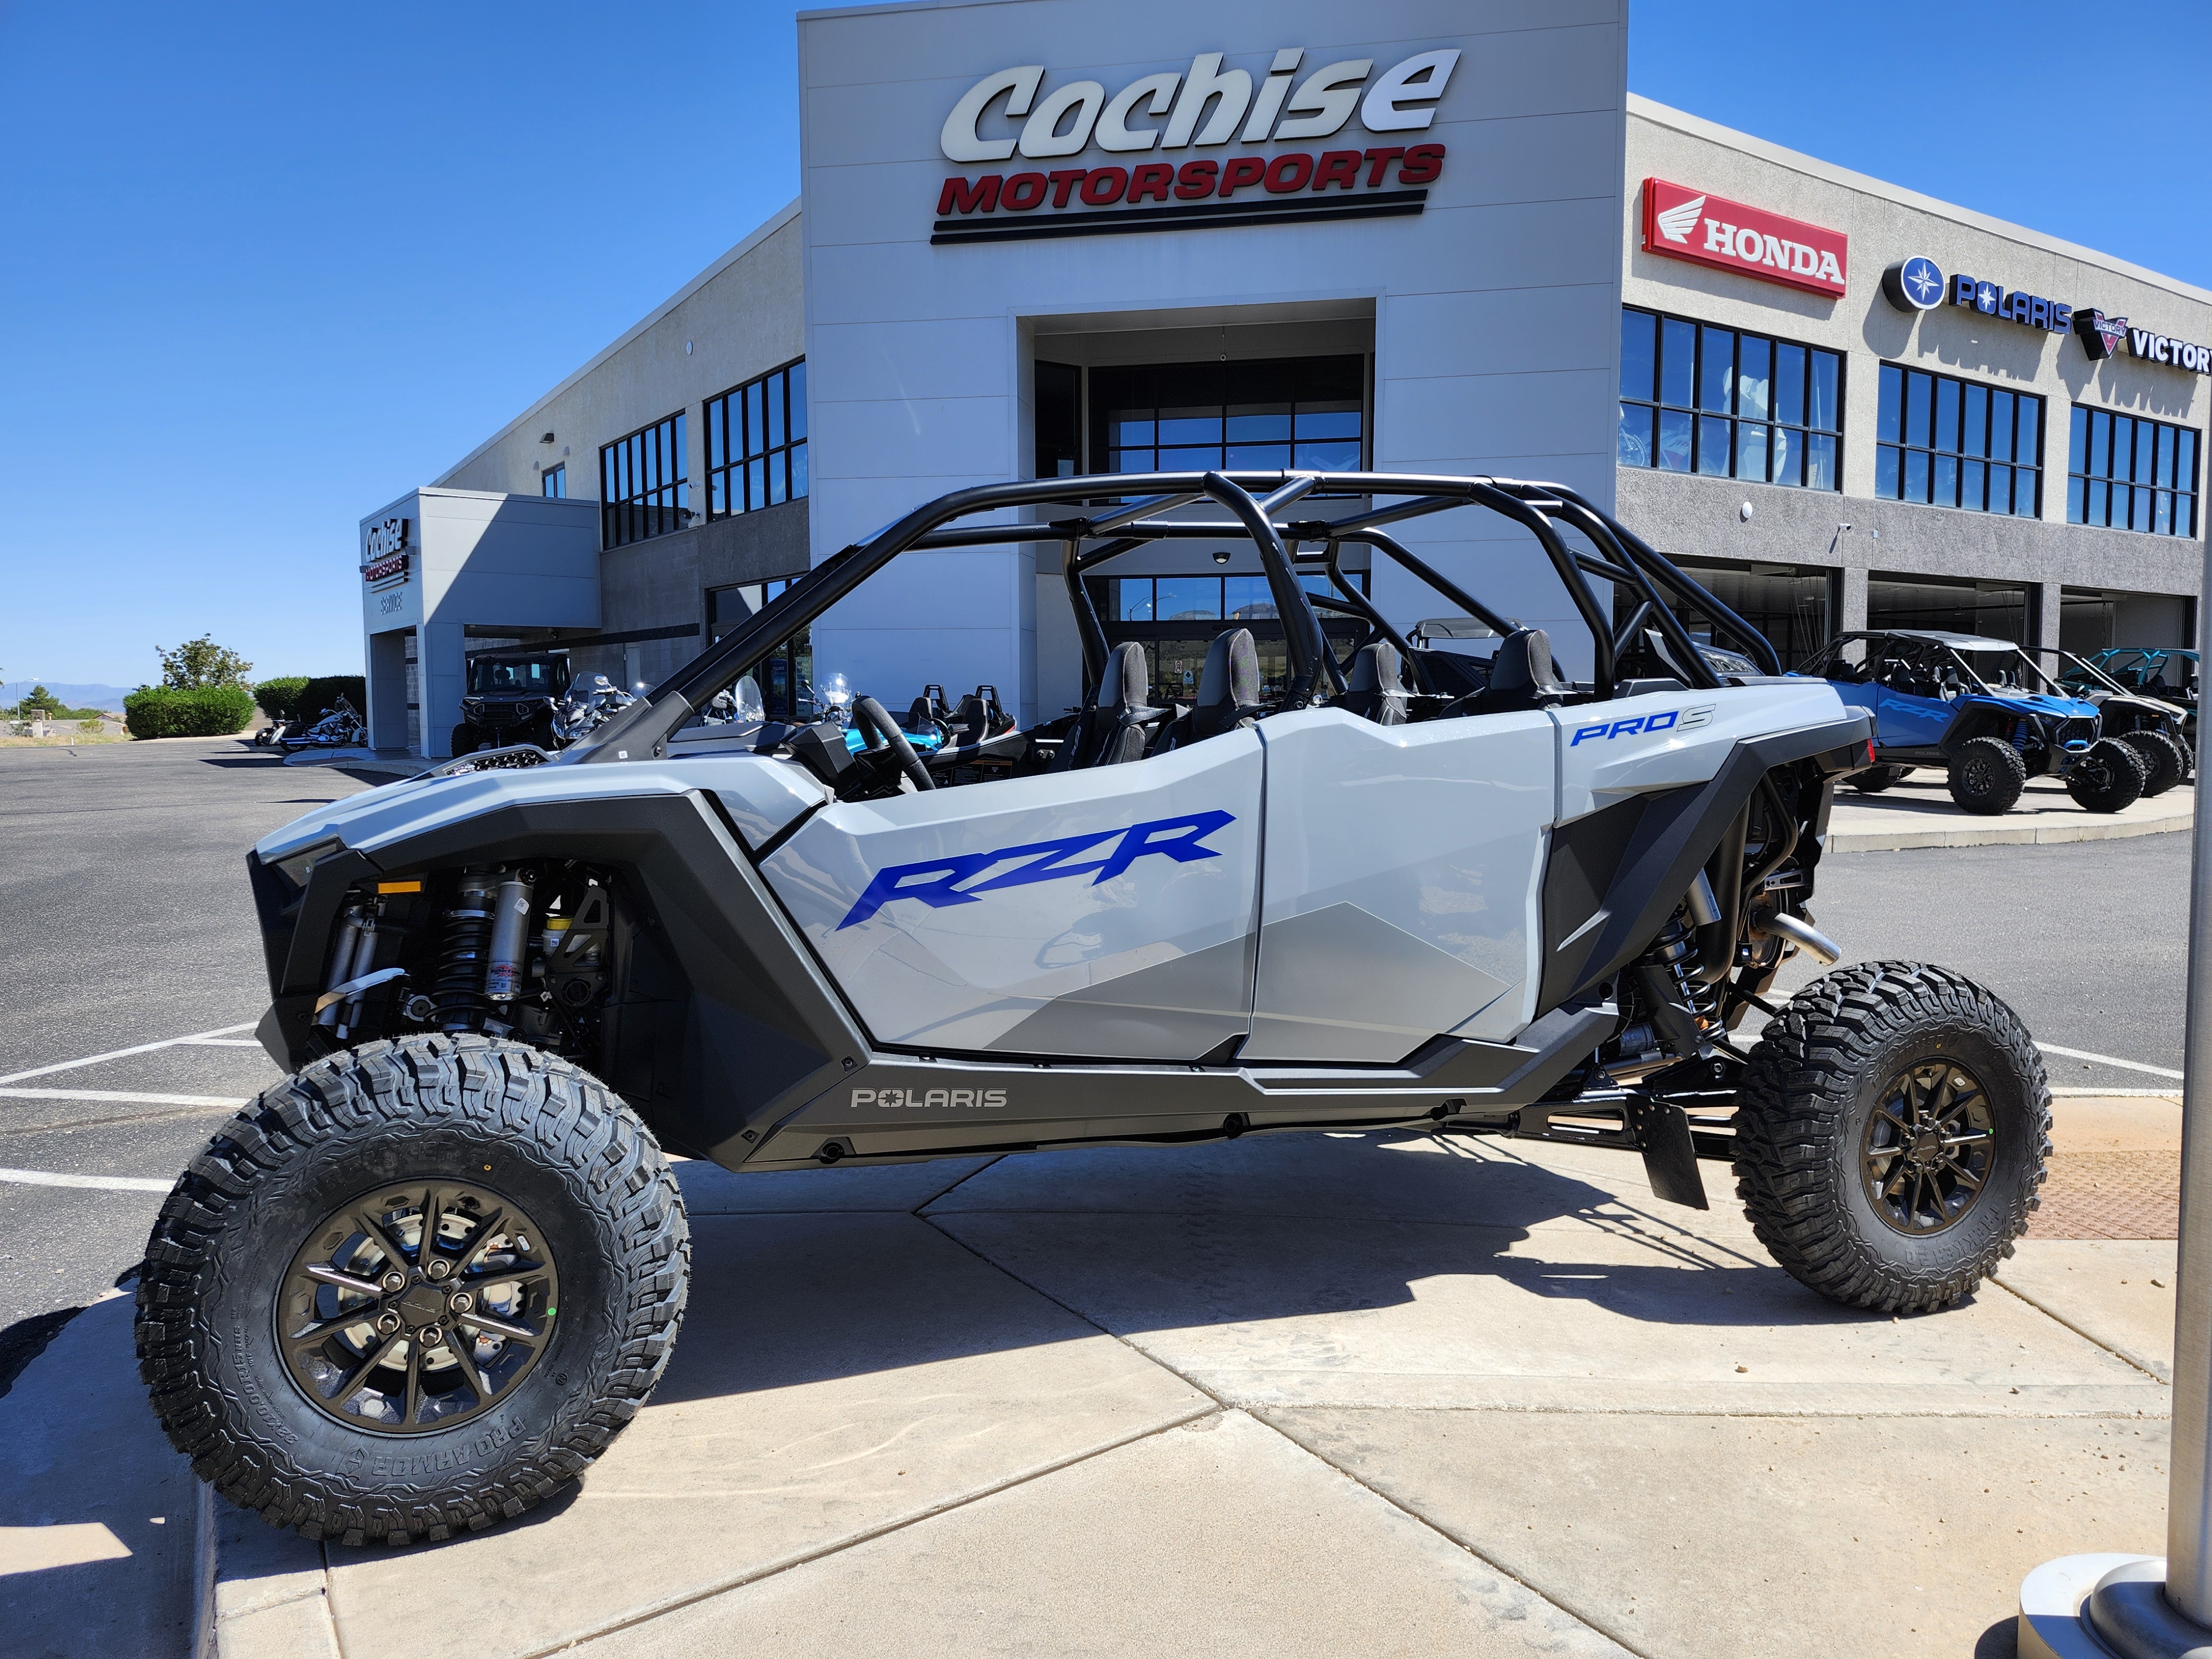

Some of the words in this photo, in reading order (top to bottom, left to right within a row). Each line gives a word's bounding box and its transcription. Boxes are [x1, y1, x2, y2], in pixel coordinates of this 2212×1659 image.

[940, 46, 1462, 163] Cochise
[937, 143, 1447, 216] MOTORSPORTS
[1703, 217, 1845, 285] HONDA
[1954, 275, 2072, 335] POLARIS
[2094, 320, 2127, 336] VICTORY
[2133, 328, 2212, 374] VICTOR
[365, 518, 403, 563] Cochise
[366, 555, 403, 582] MOTORSPORTS
[380, 591, 403, 615] SERVICE
[1570, 711, 1679, 747] PRO
[1878, 698, 1950, 723] RZR
[835, 809, 1238, 932] RZR
[851, 1087, 1008, 1108] POLARIS
[474, 1416, 527, 1457] PRO
[371, 1443, 473, 1477] ARMOR
